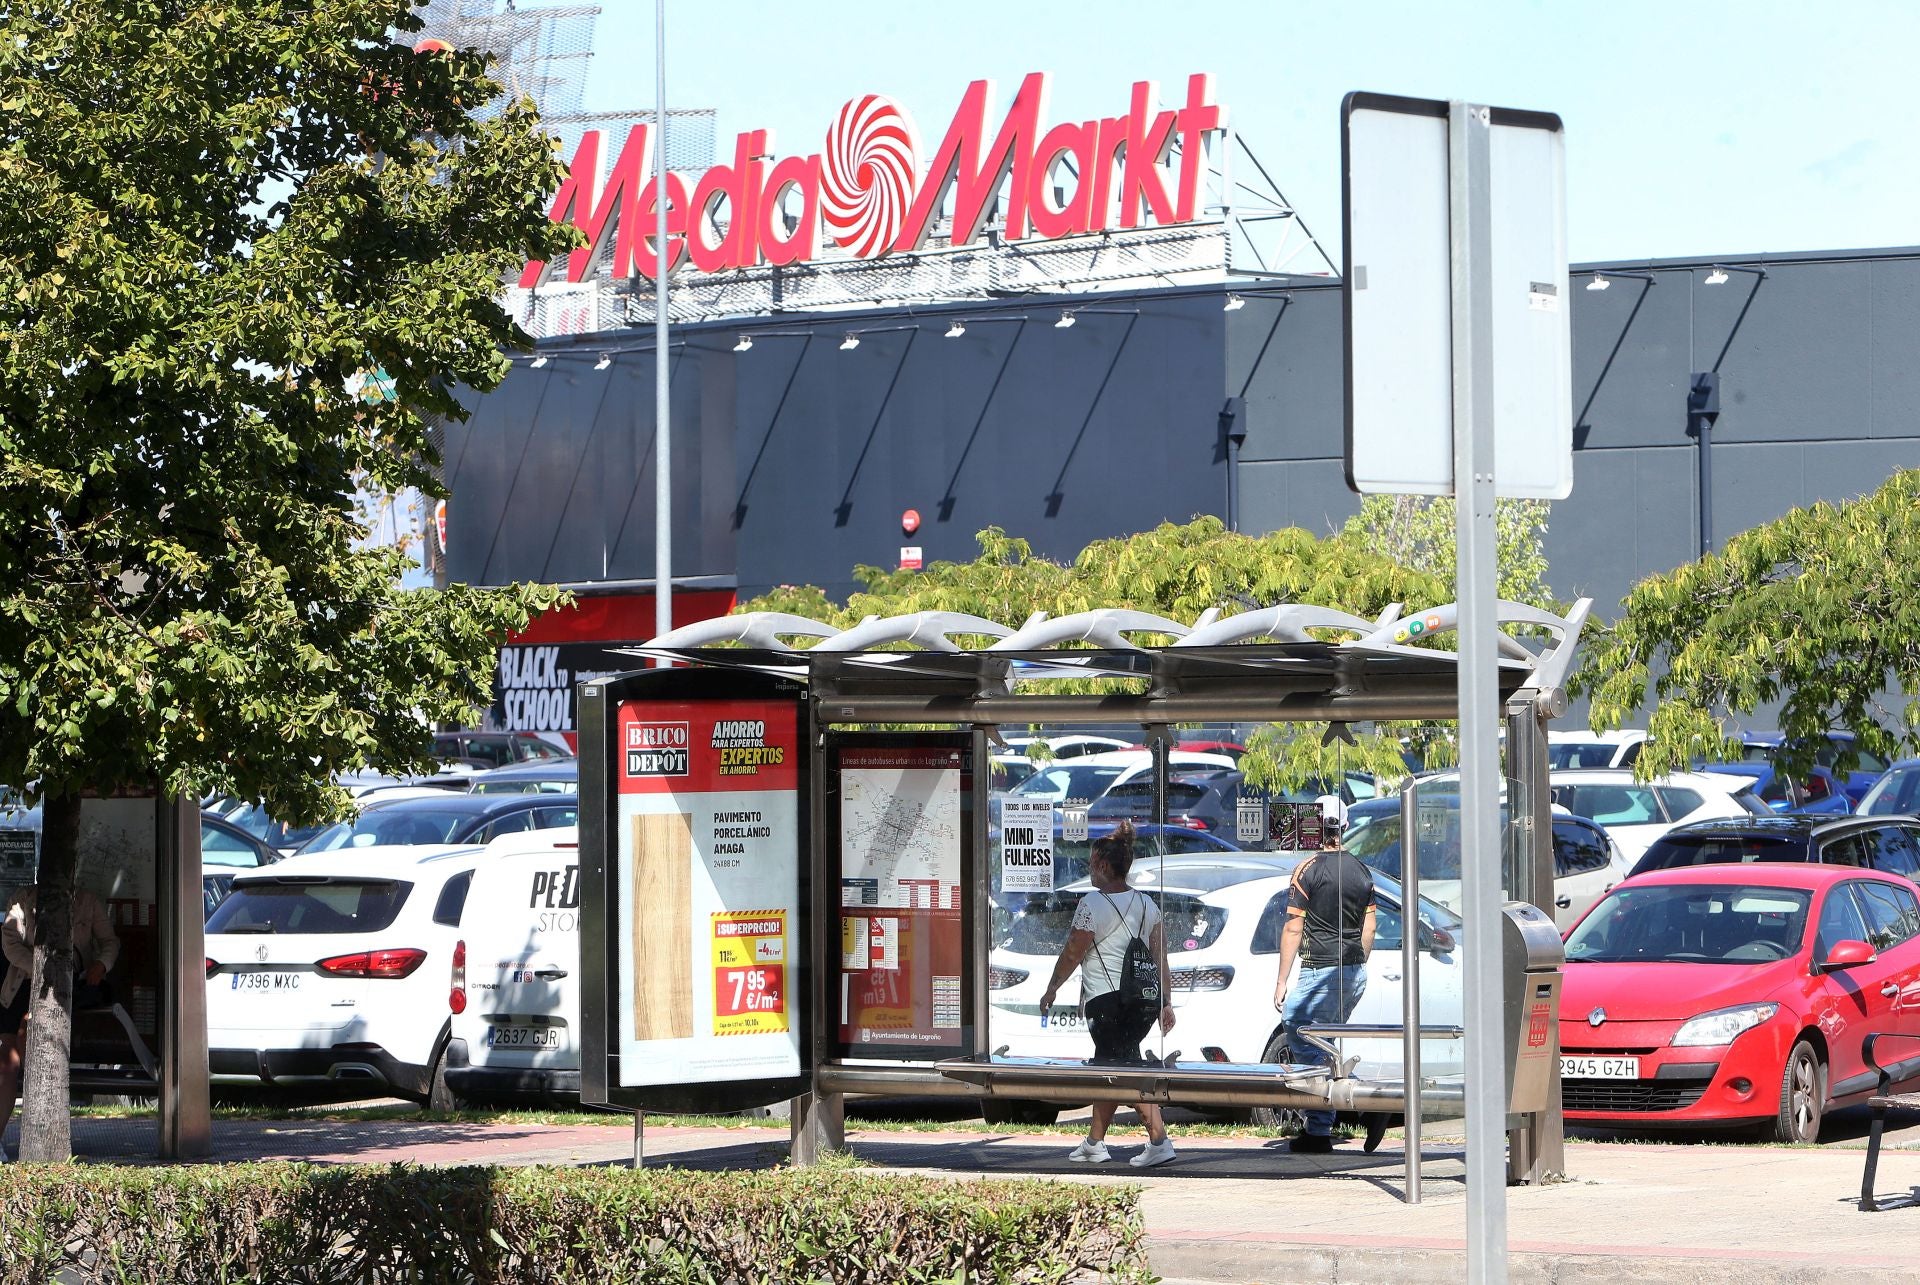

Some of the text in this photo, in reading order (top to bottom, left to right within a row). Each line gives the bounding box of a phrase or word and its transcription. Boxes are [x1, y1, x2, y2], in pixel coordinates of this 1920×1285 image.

[518, 72, 1220, 288] Media Markt
[500, 646, 559, 688] BLACK
[557, 669, 568, 688] TO
[504, 688, 572, 731] SCHOOL
[629, 727, 686, 746] BRICO
[712, 721, 765, 739] AHORRO
[712, 738, 765, 748] PARA EXPERTOS.
[720, 747, 784, 765] EXPERTOS
[720, 766, 758, 775] EN AHORRO.
[1005, 803, 1050, 811] TODOS LOS NIVELES
[714, 811, 761, 823] PAVIMENTO
[714, 825, 771, 839] PORCELÁNICO
[1005, 827, 1033, 845] MIND
[714, 843, 745, 854] AMAGA
[732, 859, 740, 867] CM
[1005, 849, 1051, 866] FULNESS
[239, 974, 300, 988] 7396 MXC
[728, 970, 766, 1010] 7 95
[496, 1029, 557, 1045] 2637 GJR
[871, 1031, 910, 1040] Ayuntamiento
[918, 1033, 942, 1041] Logroño
[1560, 1060, 1635, 1076] 2945 GZH
